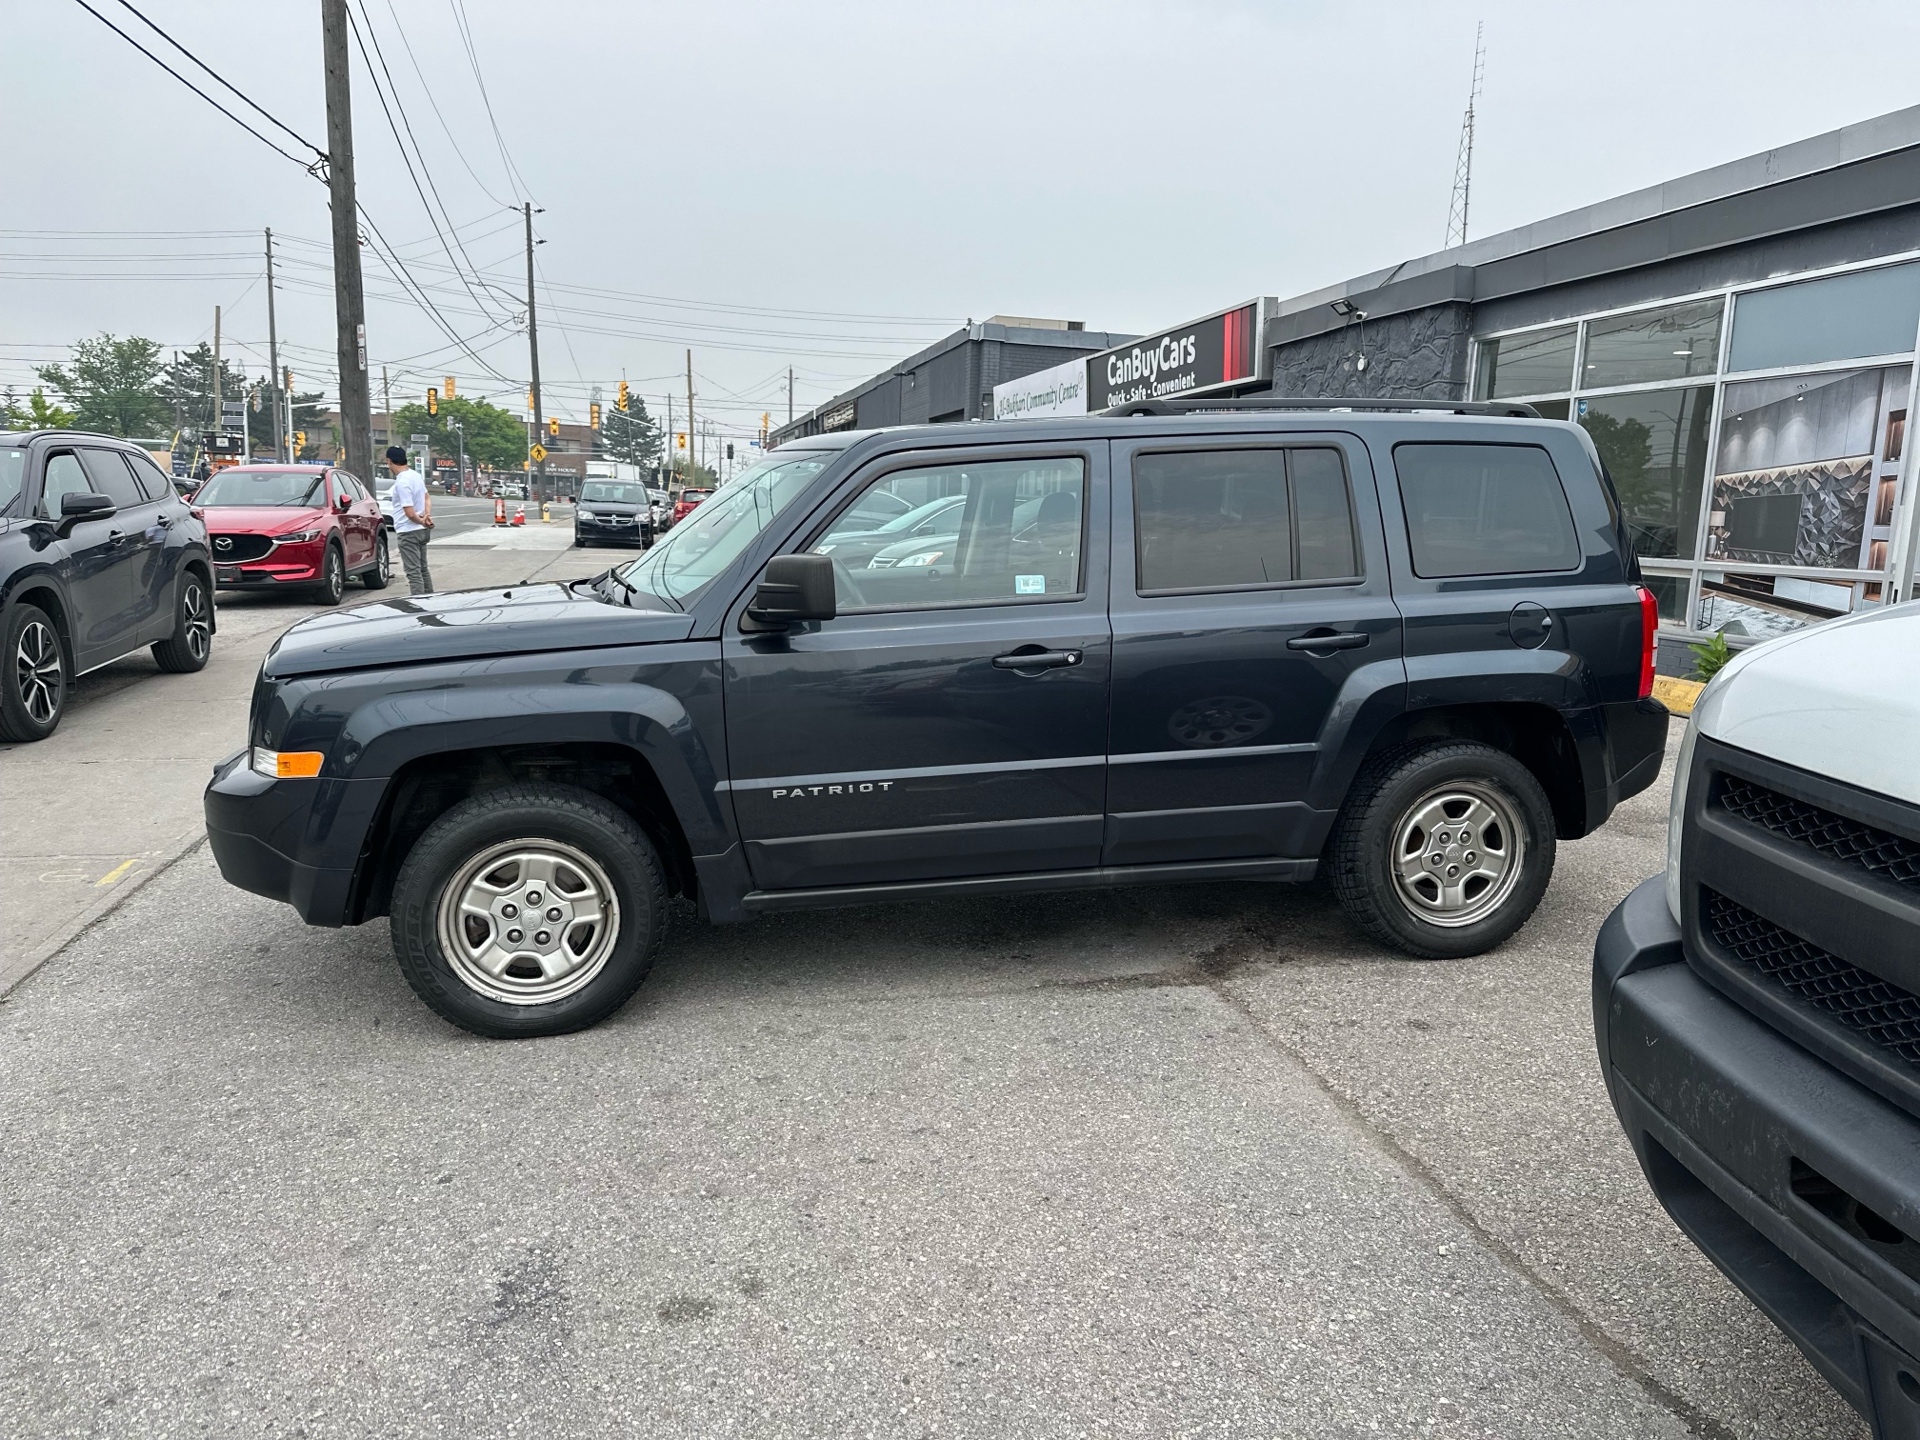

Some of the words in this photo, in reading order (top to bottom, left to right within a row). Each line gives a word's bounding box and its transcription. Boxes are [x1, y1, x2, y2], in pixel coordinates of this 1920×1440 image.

[1107, 335, 1196, 386] CanBuyCars
[1026, 385, 1057, 411] Community
[1059, 383, 1079, 404] Centre
[1107, 390, 1126, 408] Quick
[1130, 385, 1146, 401] Safe
[1152, 371, 1196, 397] Convenient
[772, 781, 894, 799] PATRIOT
[406, 903, 448, 998] COOPER
